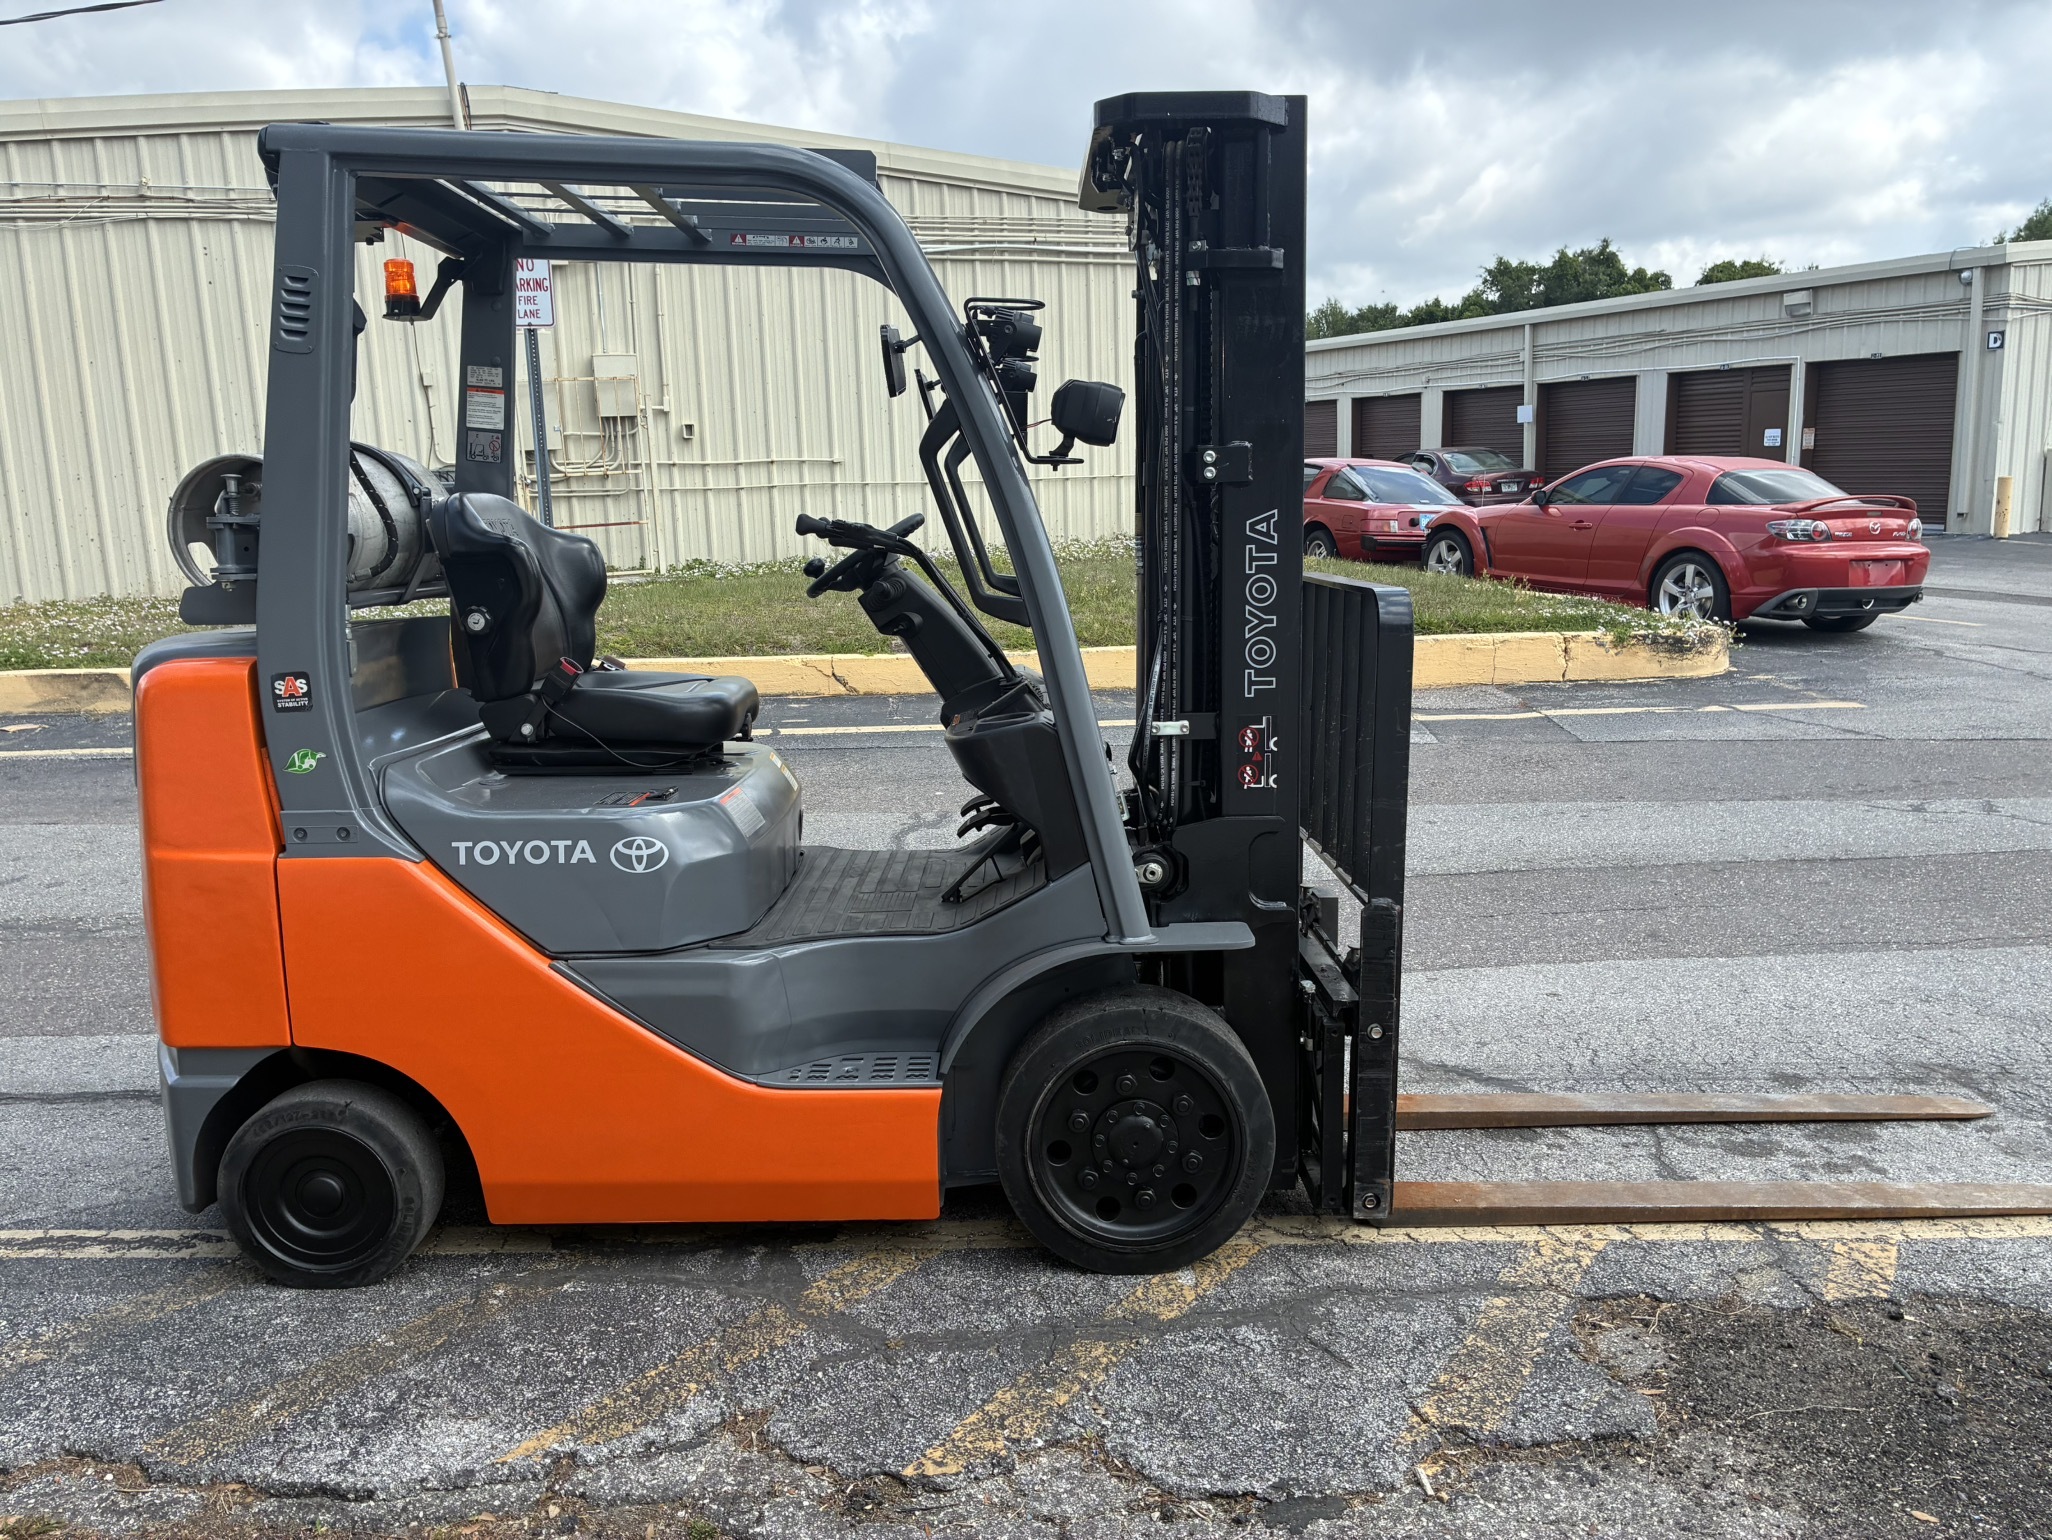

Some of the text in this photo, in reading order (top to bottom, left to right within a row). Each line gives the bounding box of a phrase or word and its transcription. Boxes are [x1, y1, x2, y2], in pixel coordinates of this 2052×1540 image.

[516, 259, 535, 272] NO
[516, 278, 549, 292] RKING
[518, 296, 538, 305] FIRE
[518, 309, 541, 319] LANE
[1989, 333, 2003, 348] D
[1245, 508, 1278, 698] TOYOTA
[274, 676, 308, 697] SAS
[452, 840, 597, 866] TOYOTA
